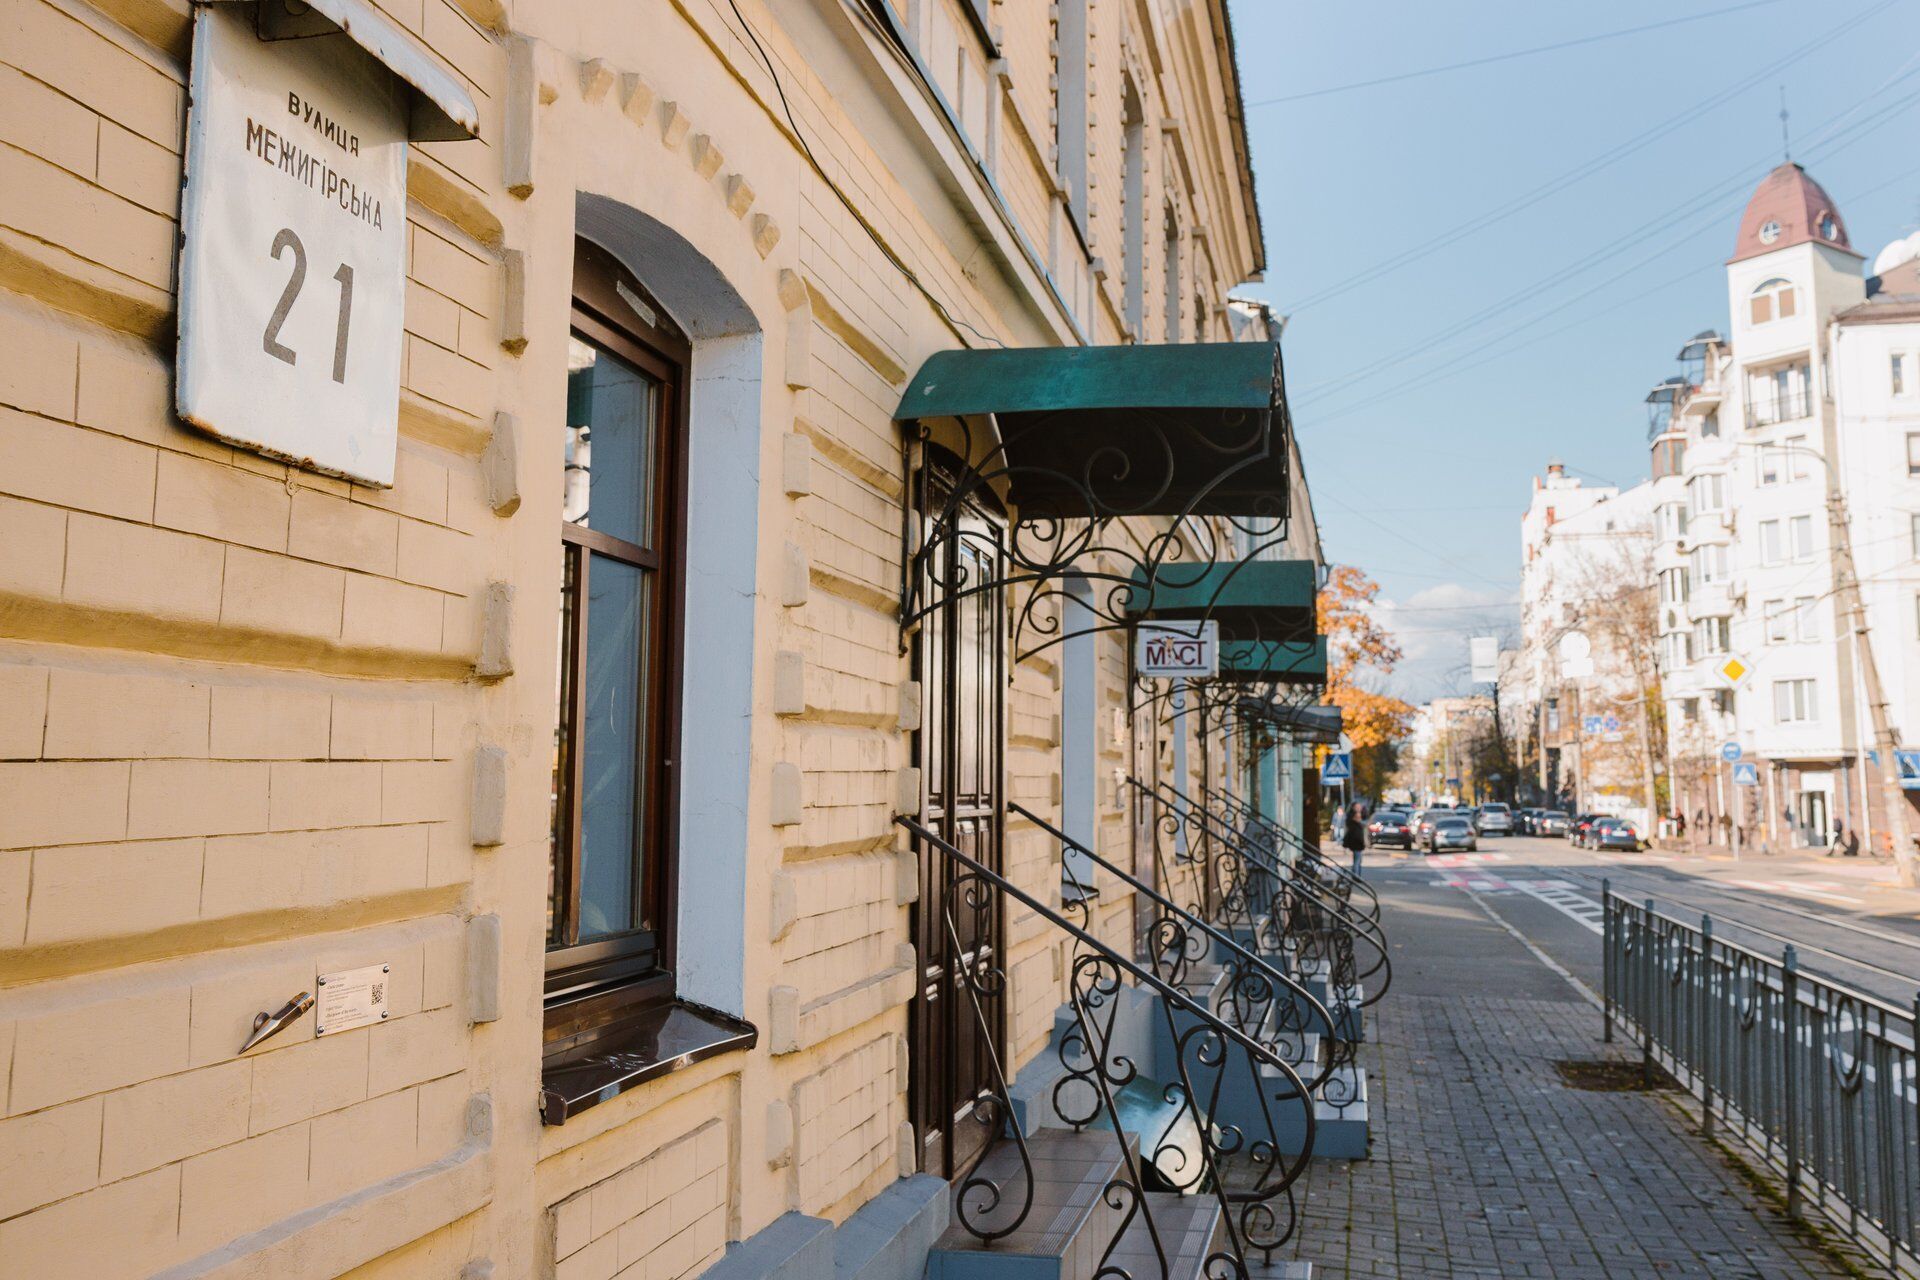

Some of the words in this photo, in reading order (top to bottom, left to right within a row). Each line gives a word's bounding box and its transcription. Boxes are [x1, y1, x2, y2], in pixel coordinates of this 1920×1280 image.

[246, 118, 382, 231] МЕЖИГІРСЬКА
[288, 91, 358, 157] ВУЛИЦЯ
[263, 228, 354, 384] 21
